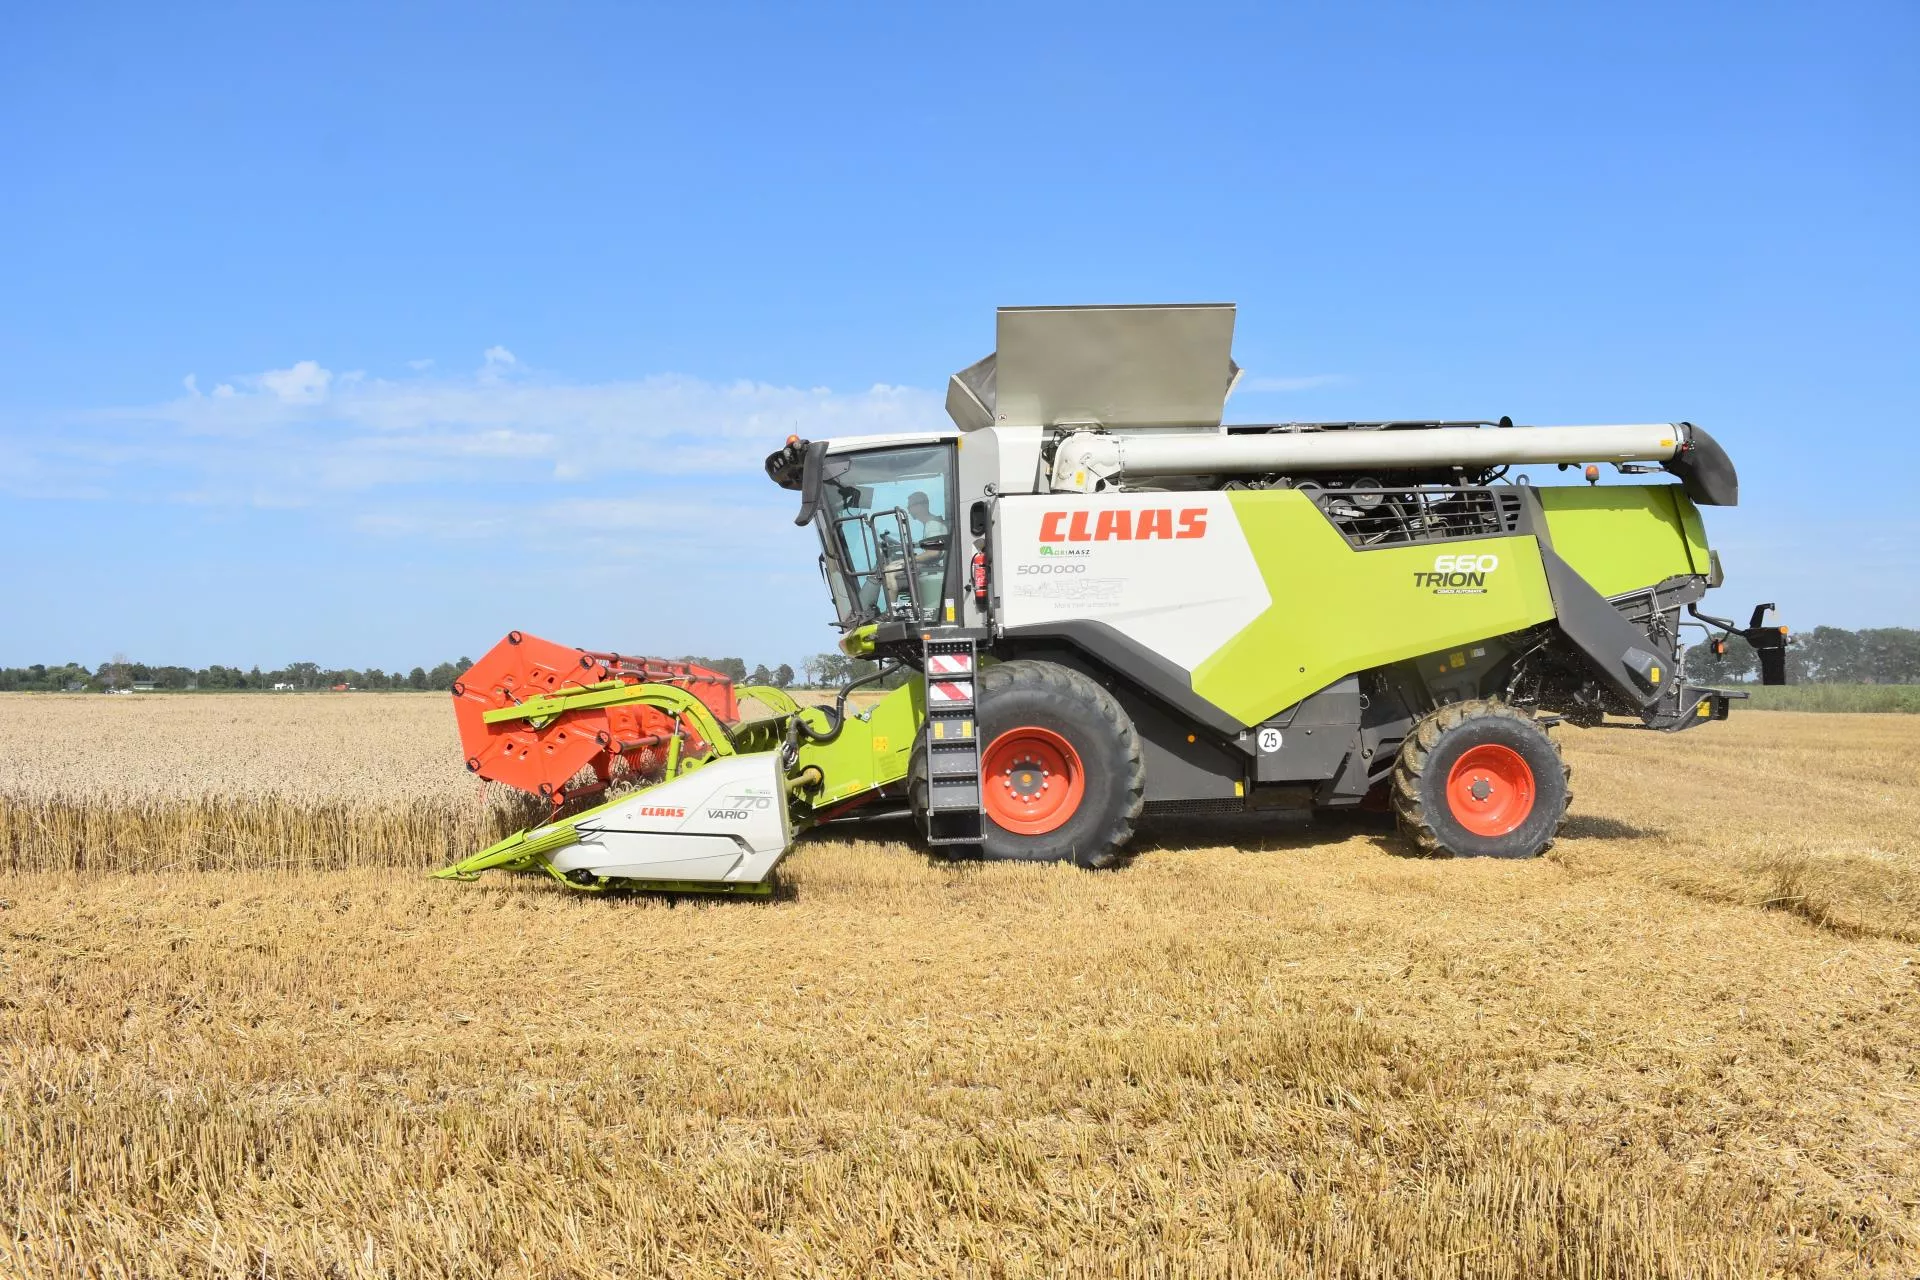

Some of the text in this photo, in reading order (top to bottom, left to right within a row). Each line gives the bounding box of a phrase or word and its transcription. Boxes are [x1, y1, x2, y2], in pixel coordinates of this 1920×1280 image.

[1039, 508, 1208, 542] CLAAS
[1435, 554, 1498, 573] 660
[1413, 572, 1486, 587] TRION
[1263, 732, 1277, 747] 25
[733, 796, 771, 809] 770
[640, 807, 685, 817] CLAAS
[707, 810, 748, 820] VARIO
